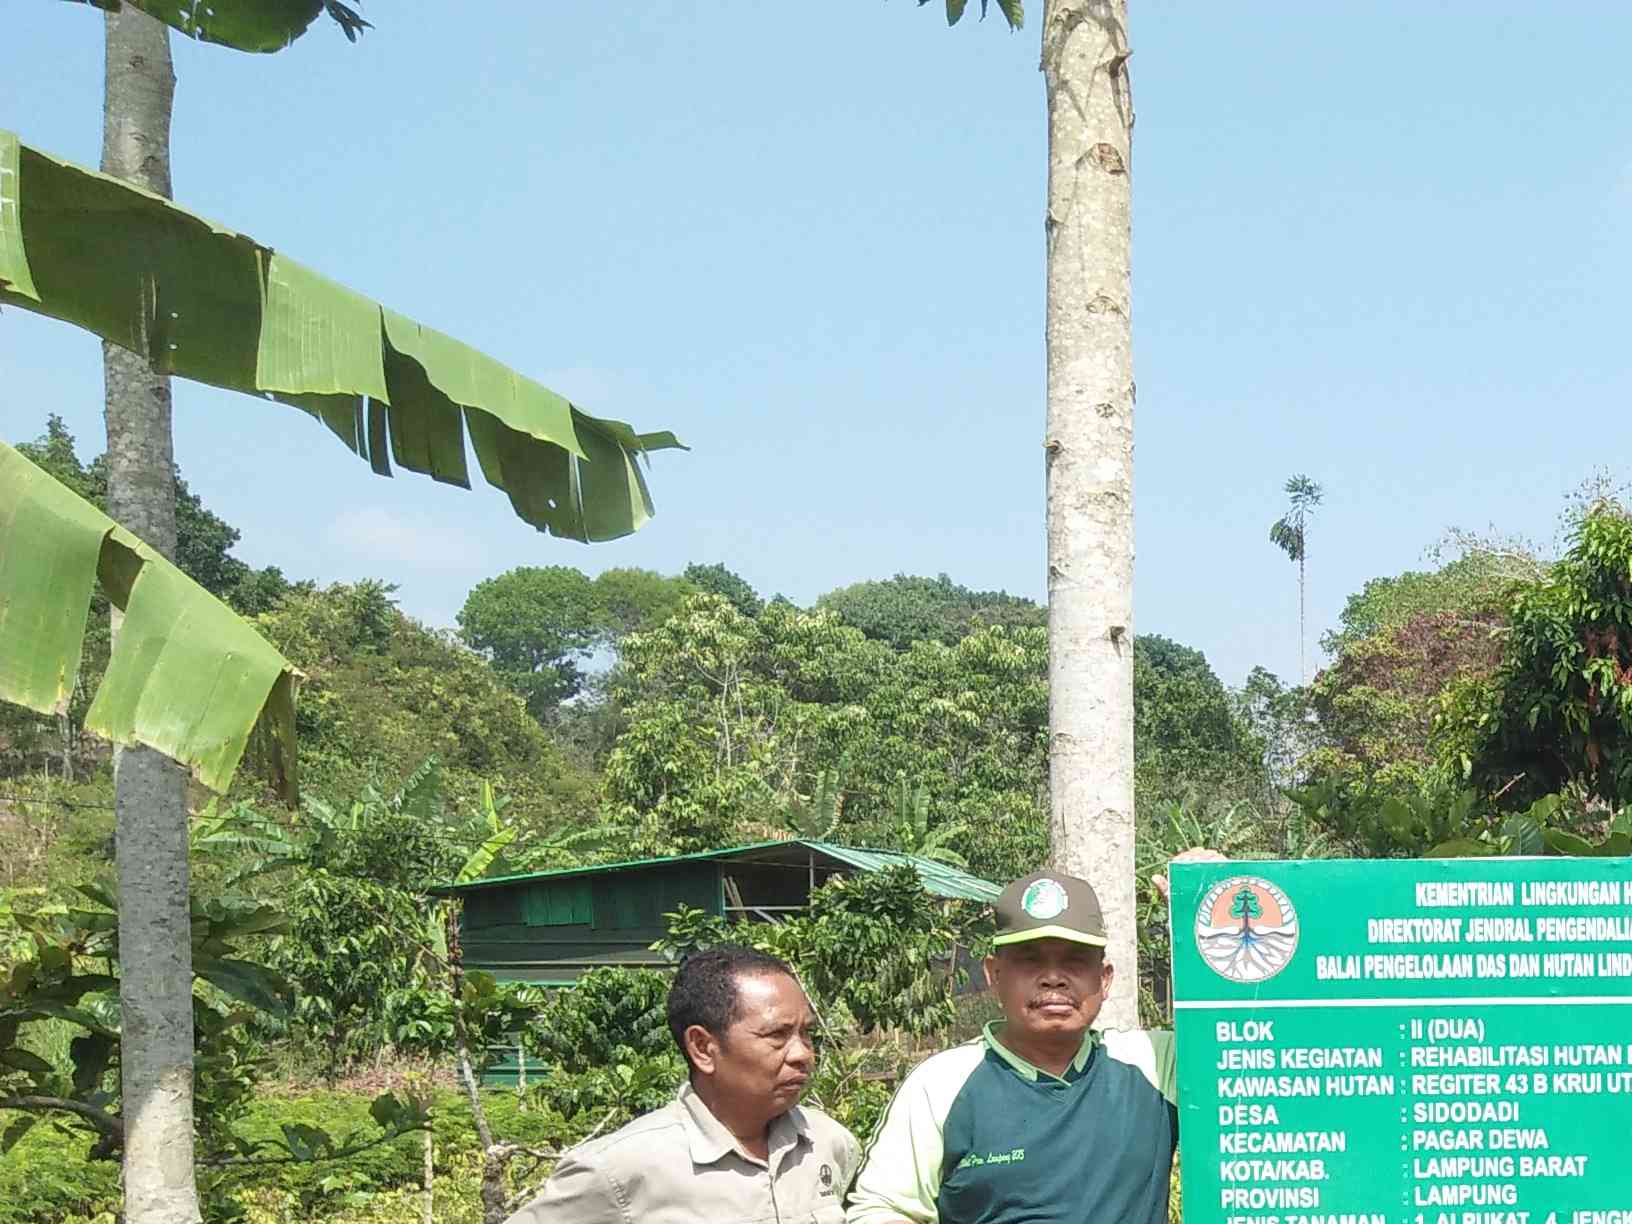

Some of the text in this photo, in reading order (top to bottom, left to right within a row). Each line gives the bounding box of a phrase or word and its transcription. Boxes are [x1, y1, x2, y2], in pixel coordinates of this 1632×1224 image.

[1415, 881, 1515, 907] KEMENTRIAN
[1521, 880, 1621, 906] LINGKUNGAN
[1367, 918, 1463, 943] DIREKTORAT
[1464, 917, 1534, 943] JENDRAL
[1316, 955, 1361, 980] BALAI
[1363, 954, 1473, 979] PENGELOLAAN
[1475, 953, 1507, 978] DAS
[1508, 953, 1541, 978] DAN
[1543, 953, 1595, 978] HUTAN
[1215, 1020, 1275, 1042] BLOK
[1410, 1019, 1423, 1040] II
[1427, 1018, 1485, 1043] (DUA)
[1216, 1048, 1276, 1070] JENIS
[1280, 1047, 1383, 1069] KEGIATAN
[1410, 1045, 1549, 1067] REHABILITASI
[1553, 1044, 1623, 1066] HUTAN
[1217, 1076, 1321, 1098] KAWASAN
[1325, 1074, 1395, 1097] HUTAN
[1411, 1073, 1501, 1095] REGITER
[1504, 1073, 1529, 1094] 43
[1533, 1072, 1548, 1094] B
[1552, 1072, 1602, 1094] KRUI
[1218, 1103, 1280, 1126] DESA
[1413, 1101, 1520, 1123] SIDODADI
[1219, 1131, 1346, 1154] KECAMATAN
[1412, 1129, 1484, 1151] PAGAR
[1488, 1128, 1549, 1150] DEWA
[1219, 1159, 1330, 1182] KOTA/KAB.
[1413, 1156, 1515, 1179] LAMPUNG
[1519, 1155, 1588, 1177] BARAT
[1221, 1186, 1320, 1209] PROVINSI
[1414, 1184, 1518, 1207] LAMPUNG
